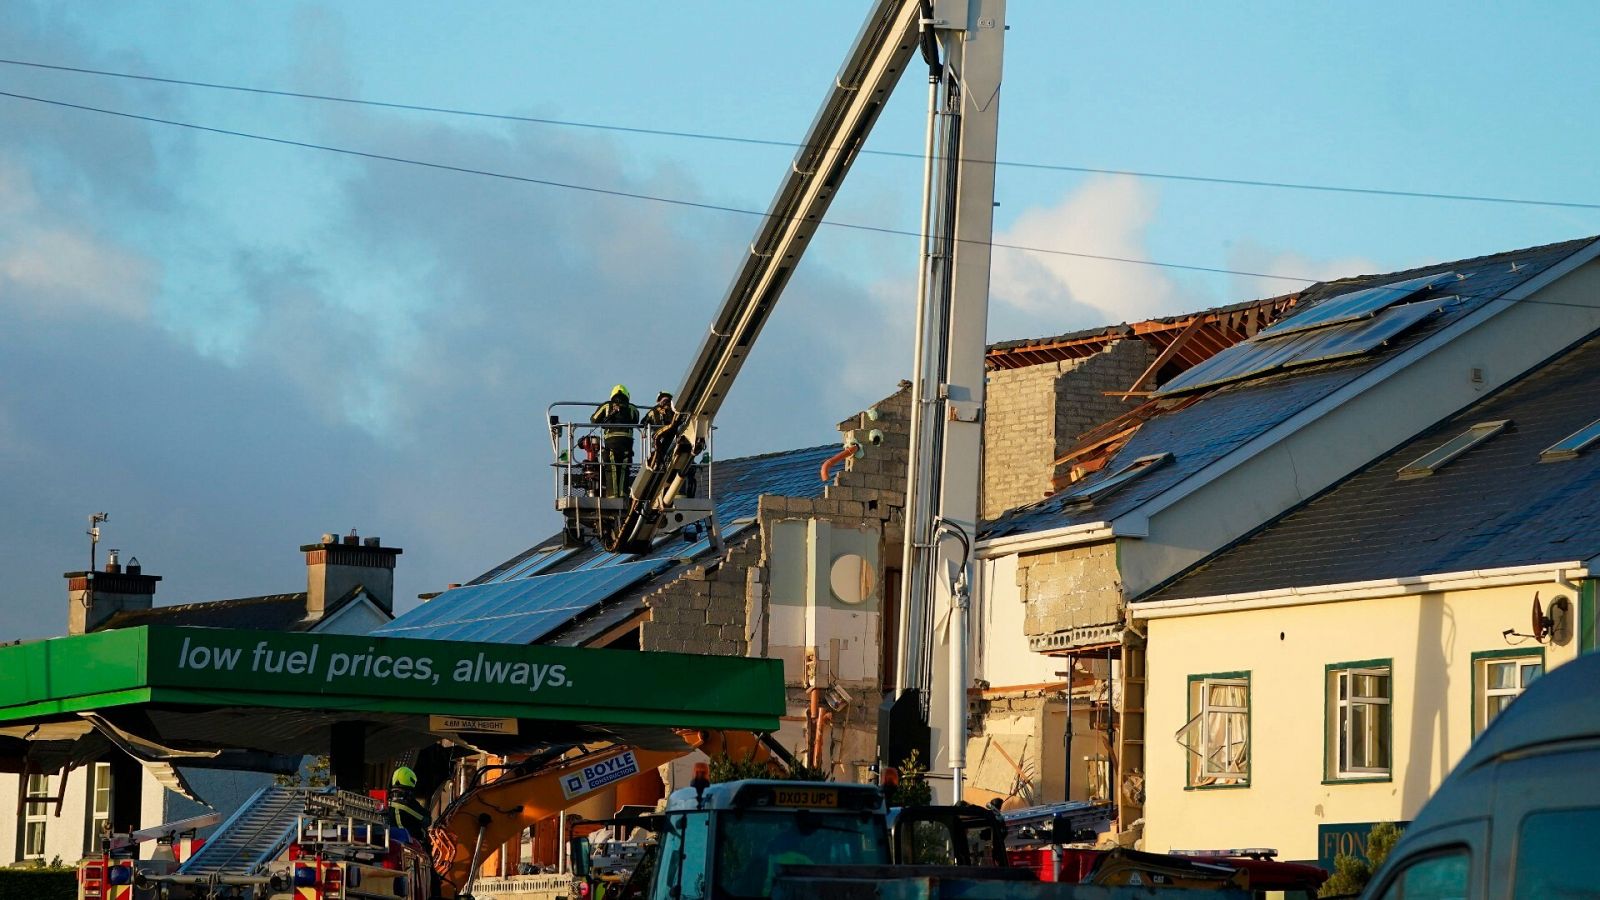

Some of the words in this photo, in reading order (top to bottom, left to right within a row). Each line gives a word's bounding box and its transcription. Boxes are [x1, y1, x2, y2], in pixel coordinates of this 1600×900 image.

[178, 637, 242, 670] low
[252, 641, 319, 674] fuel
[326, 646, 439, 686] prices,
[453, 652, 573, 692] always.
[462, 720, 476, 728] MAX
[478, 721, 504, 729] HEIGHT
[584, 752, 634, 780] BOYLE
[591, 767, 635, 787] CONSTRUCTION
[779, 791, 808, 804] DX03
[811, 791, 834, 805] UPC
[1324, 832, 1369, 859] FION
[1153, 875, 1164, 883] CAT
